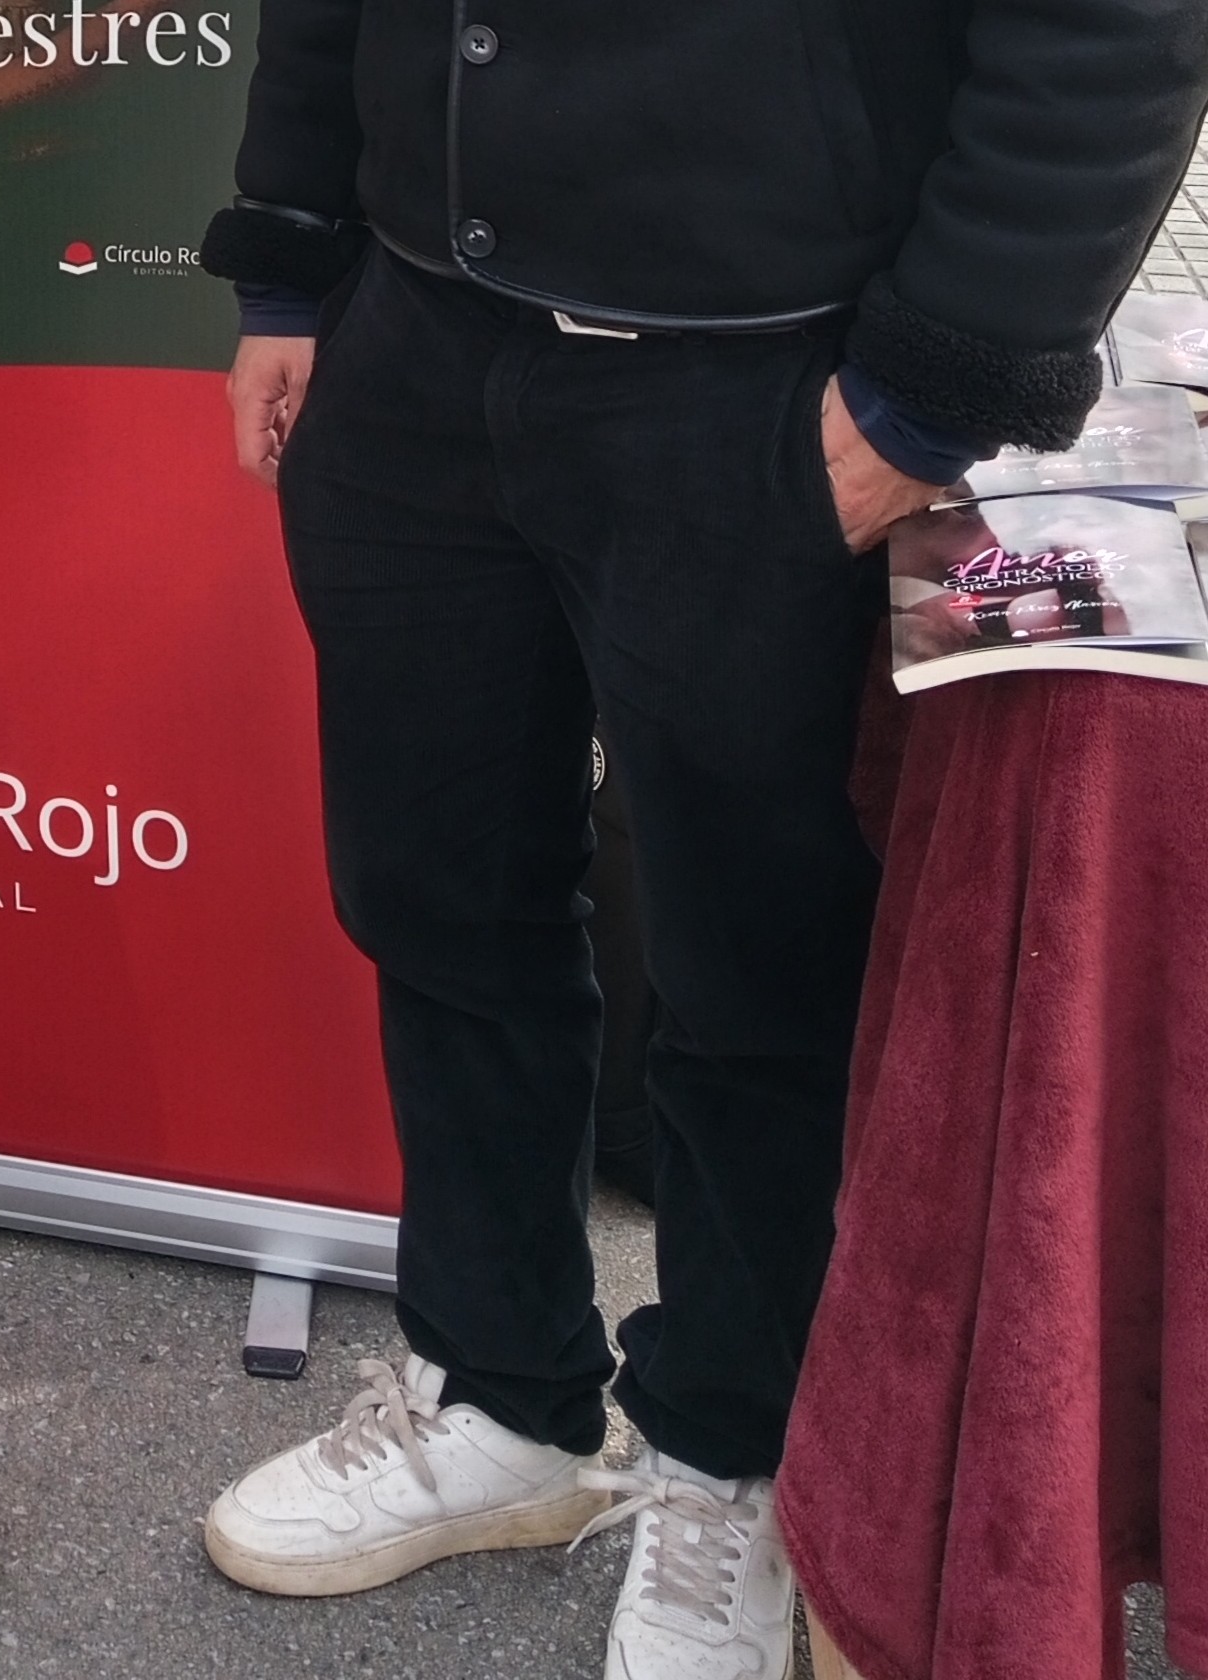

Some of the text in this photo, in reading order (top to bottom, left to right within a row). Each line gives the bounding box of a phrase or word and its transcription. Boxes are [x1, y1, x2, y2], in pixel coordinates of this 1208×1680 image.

[104, 244, 201, 265] Círculo Ro
[133, 268, 189, 277] EDITORIAL
[947, 546, 1129, 579] Amor
[943, 566, 1046, 588] CONTRA
